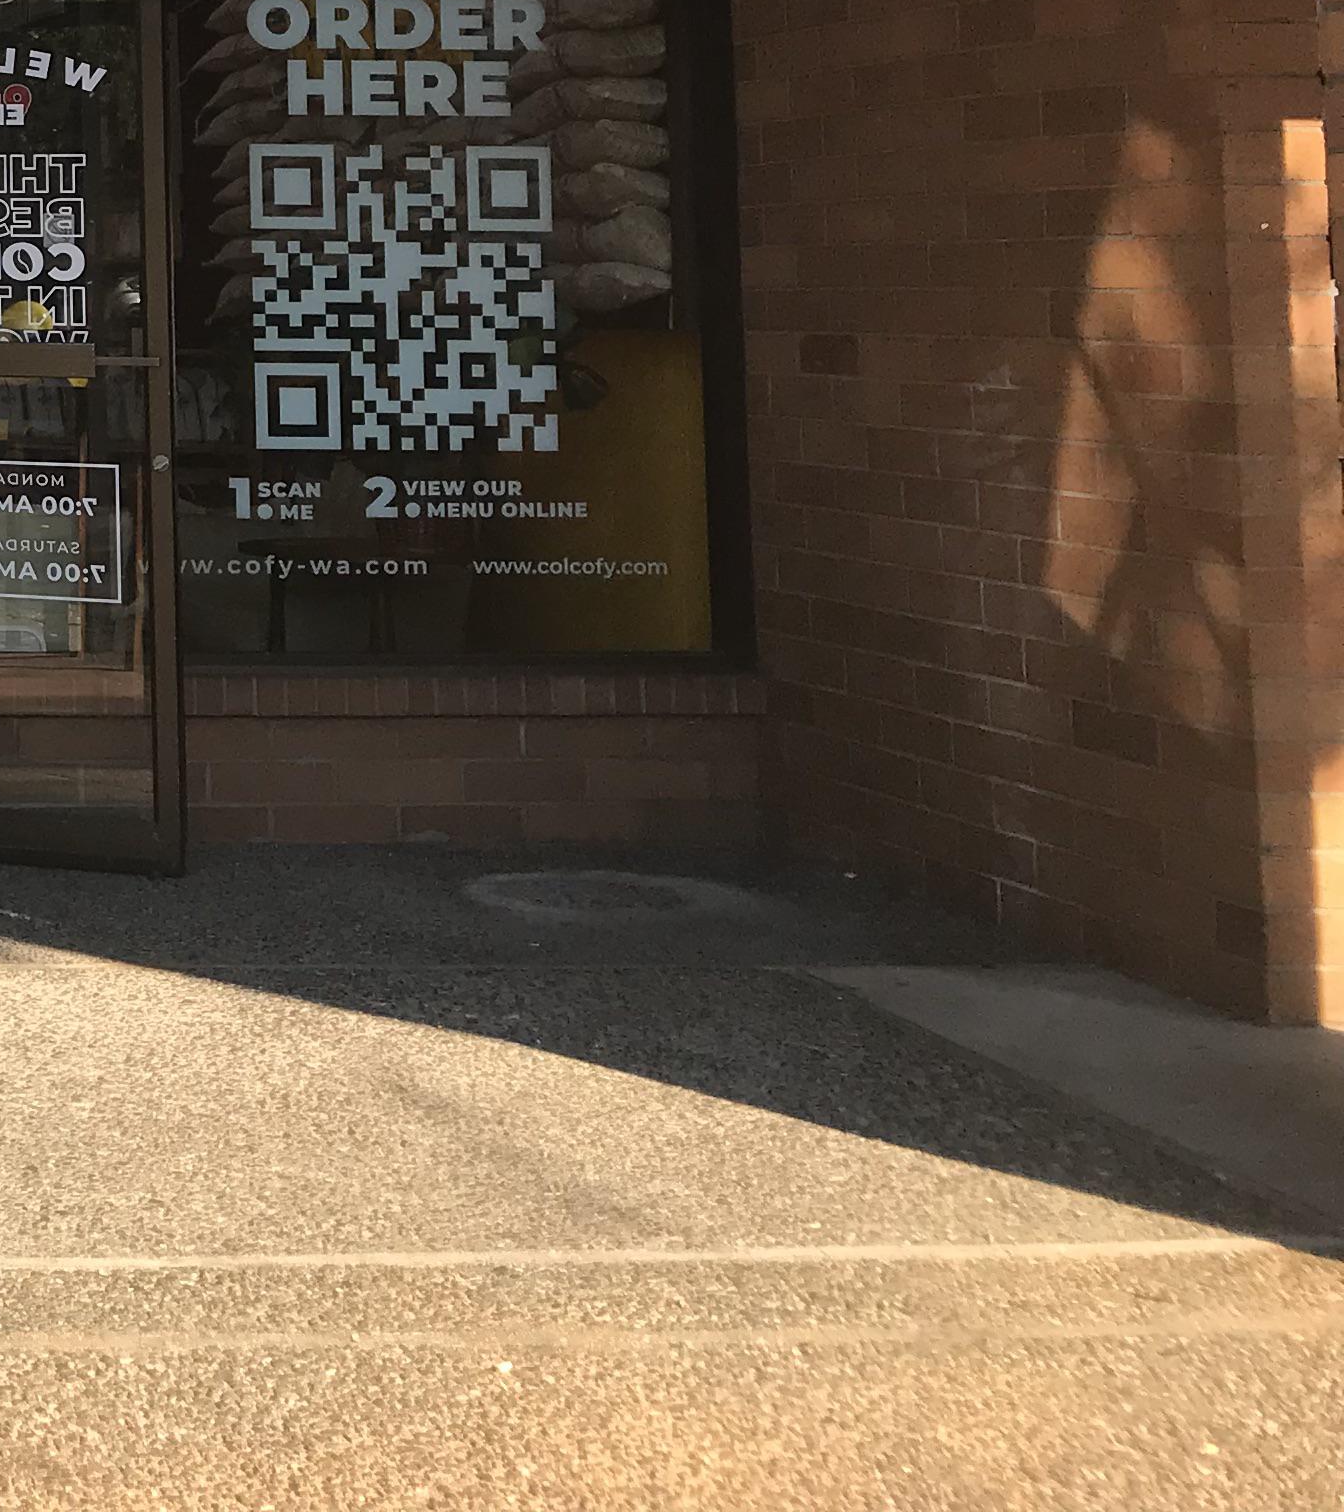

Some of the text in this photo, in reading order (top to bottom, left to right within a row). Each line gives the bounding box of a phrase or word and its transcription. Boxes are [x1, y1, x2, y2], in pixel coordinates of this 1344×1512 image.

[287, 59, 512, 117] HERE
[258, 482, 321, 498] SCAN
[403, 480, 465, 496] VIEW
[473, 480, 522, 497] OUR
[280, 504, 314, 520] ME
[428, 502, 587, 518] MENU ONLINE
[473, 557, 668, 579] www.colcofy.com
